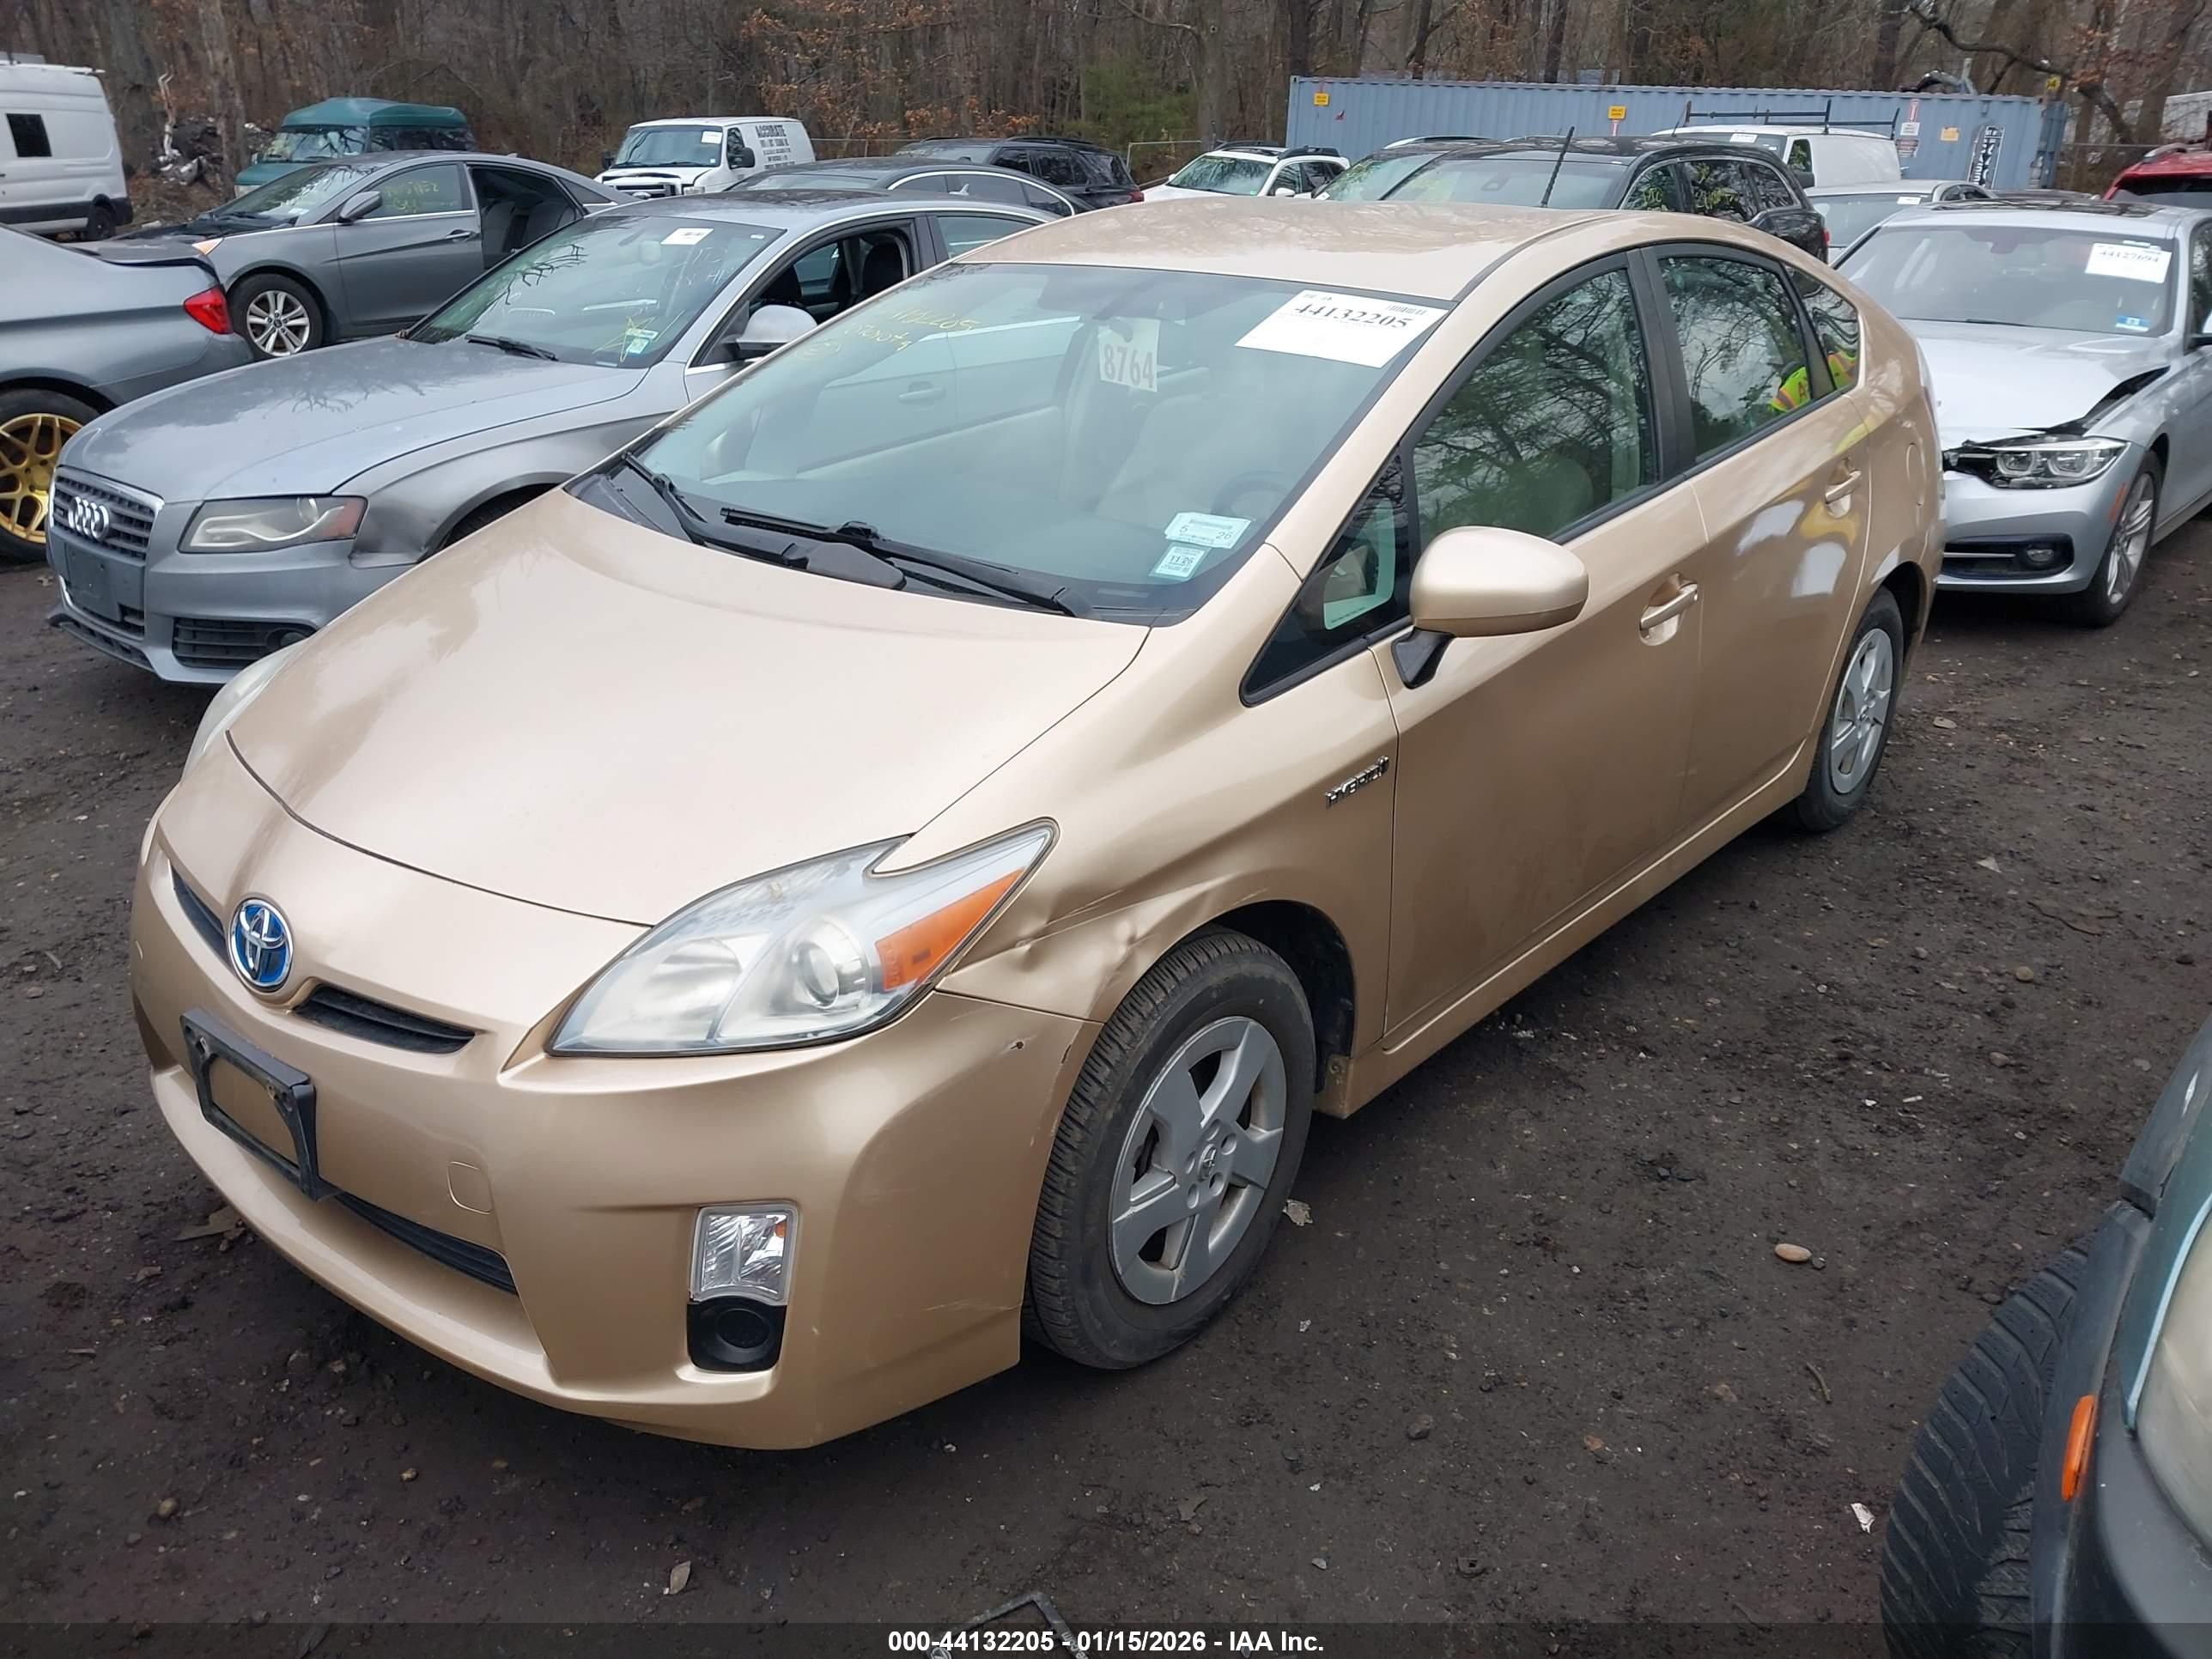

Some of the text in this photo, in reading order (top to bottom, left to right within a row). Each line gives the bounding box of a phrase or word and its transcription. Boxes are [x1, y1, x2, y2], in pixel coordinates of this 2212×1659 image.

[1294, 302, 1413, 329] 44132205
[1103, 343, 1155, 390] 8764
[1215, 531, 1234, 541] 26
[1325, 755, 1389, 808] HYBRID
